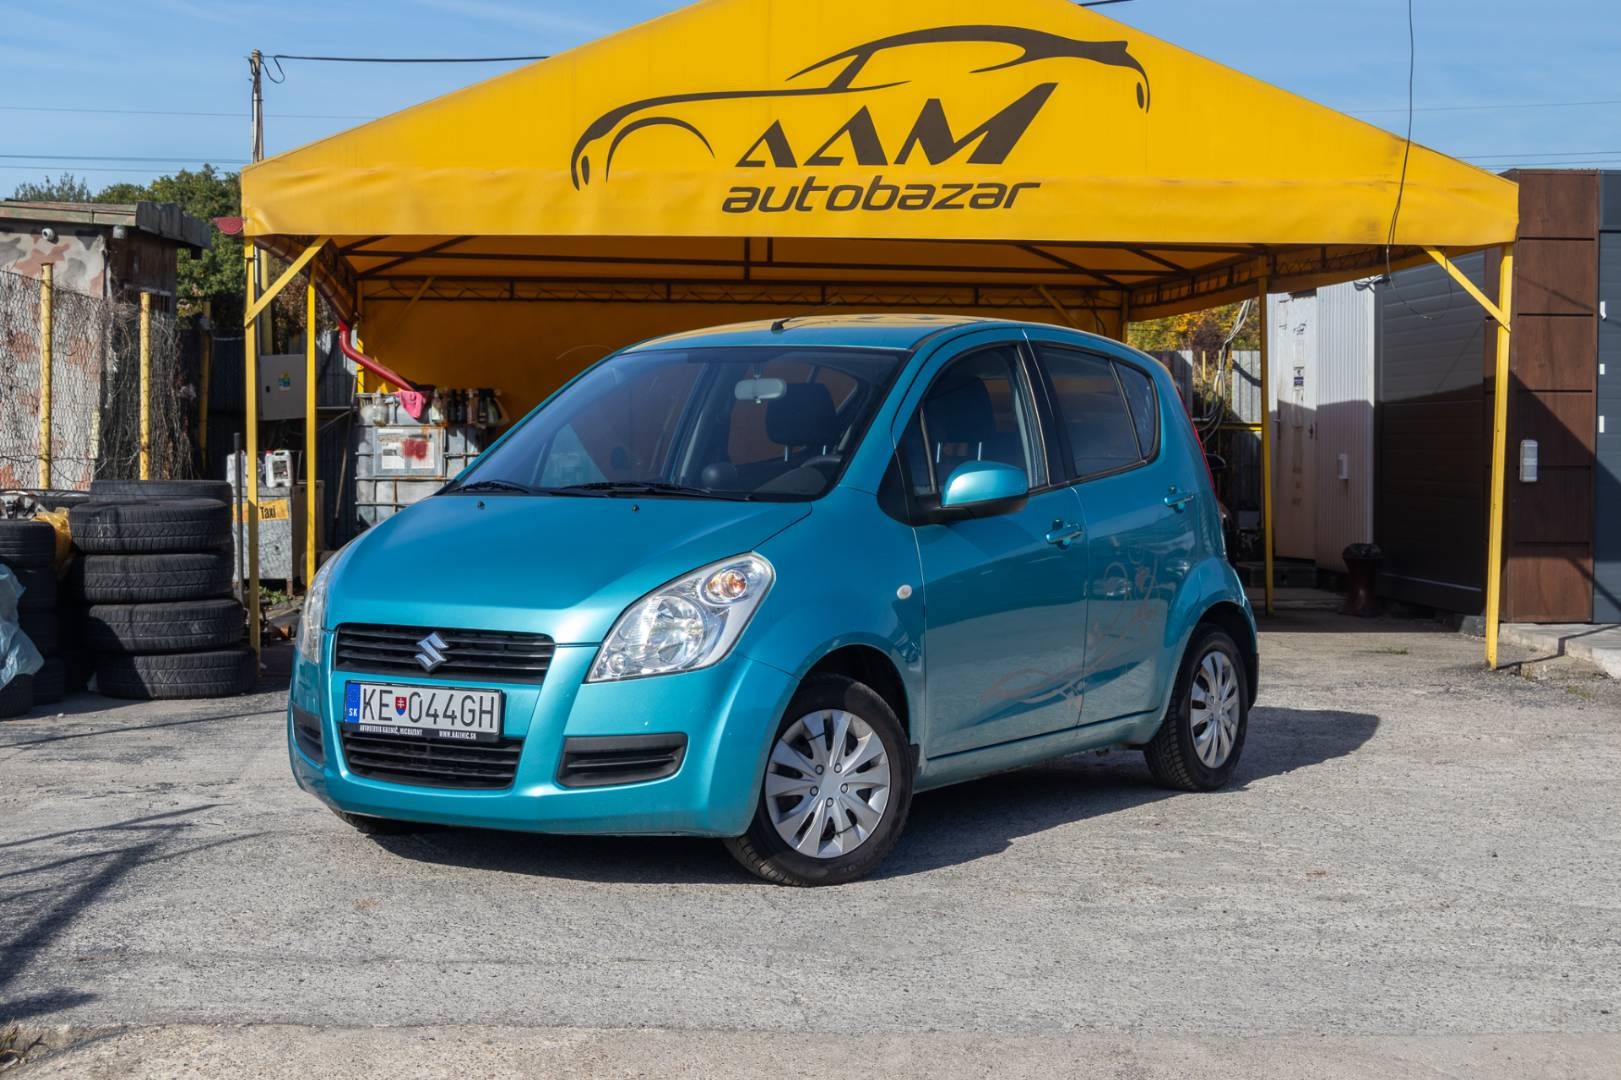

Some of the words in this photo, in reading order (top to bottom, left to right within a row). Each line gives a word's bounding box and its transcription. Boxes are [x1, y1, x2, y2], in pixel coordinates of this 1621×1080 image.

[735, 82, 1058, 168] AAM
[721, 175, 1041, 213] autobazar
[259, 505, 276, 519] Taxi
[348, 708, 358, 717] SK
[362, 688, 393, 721] KE
[408, 691, 495, 729] 044GH
